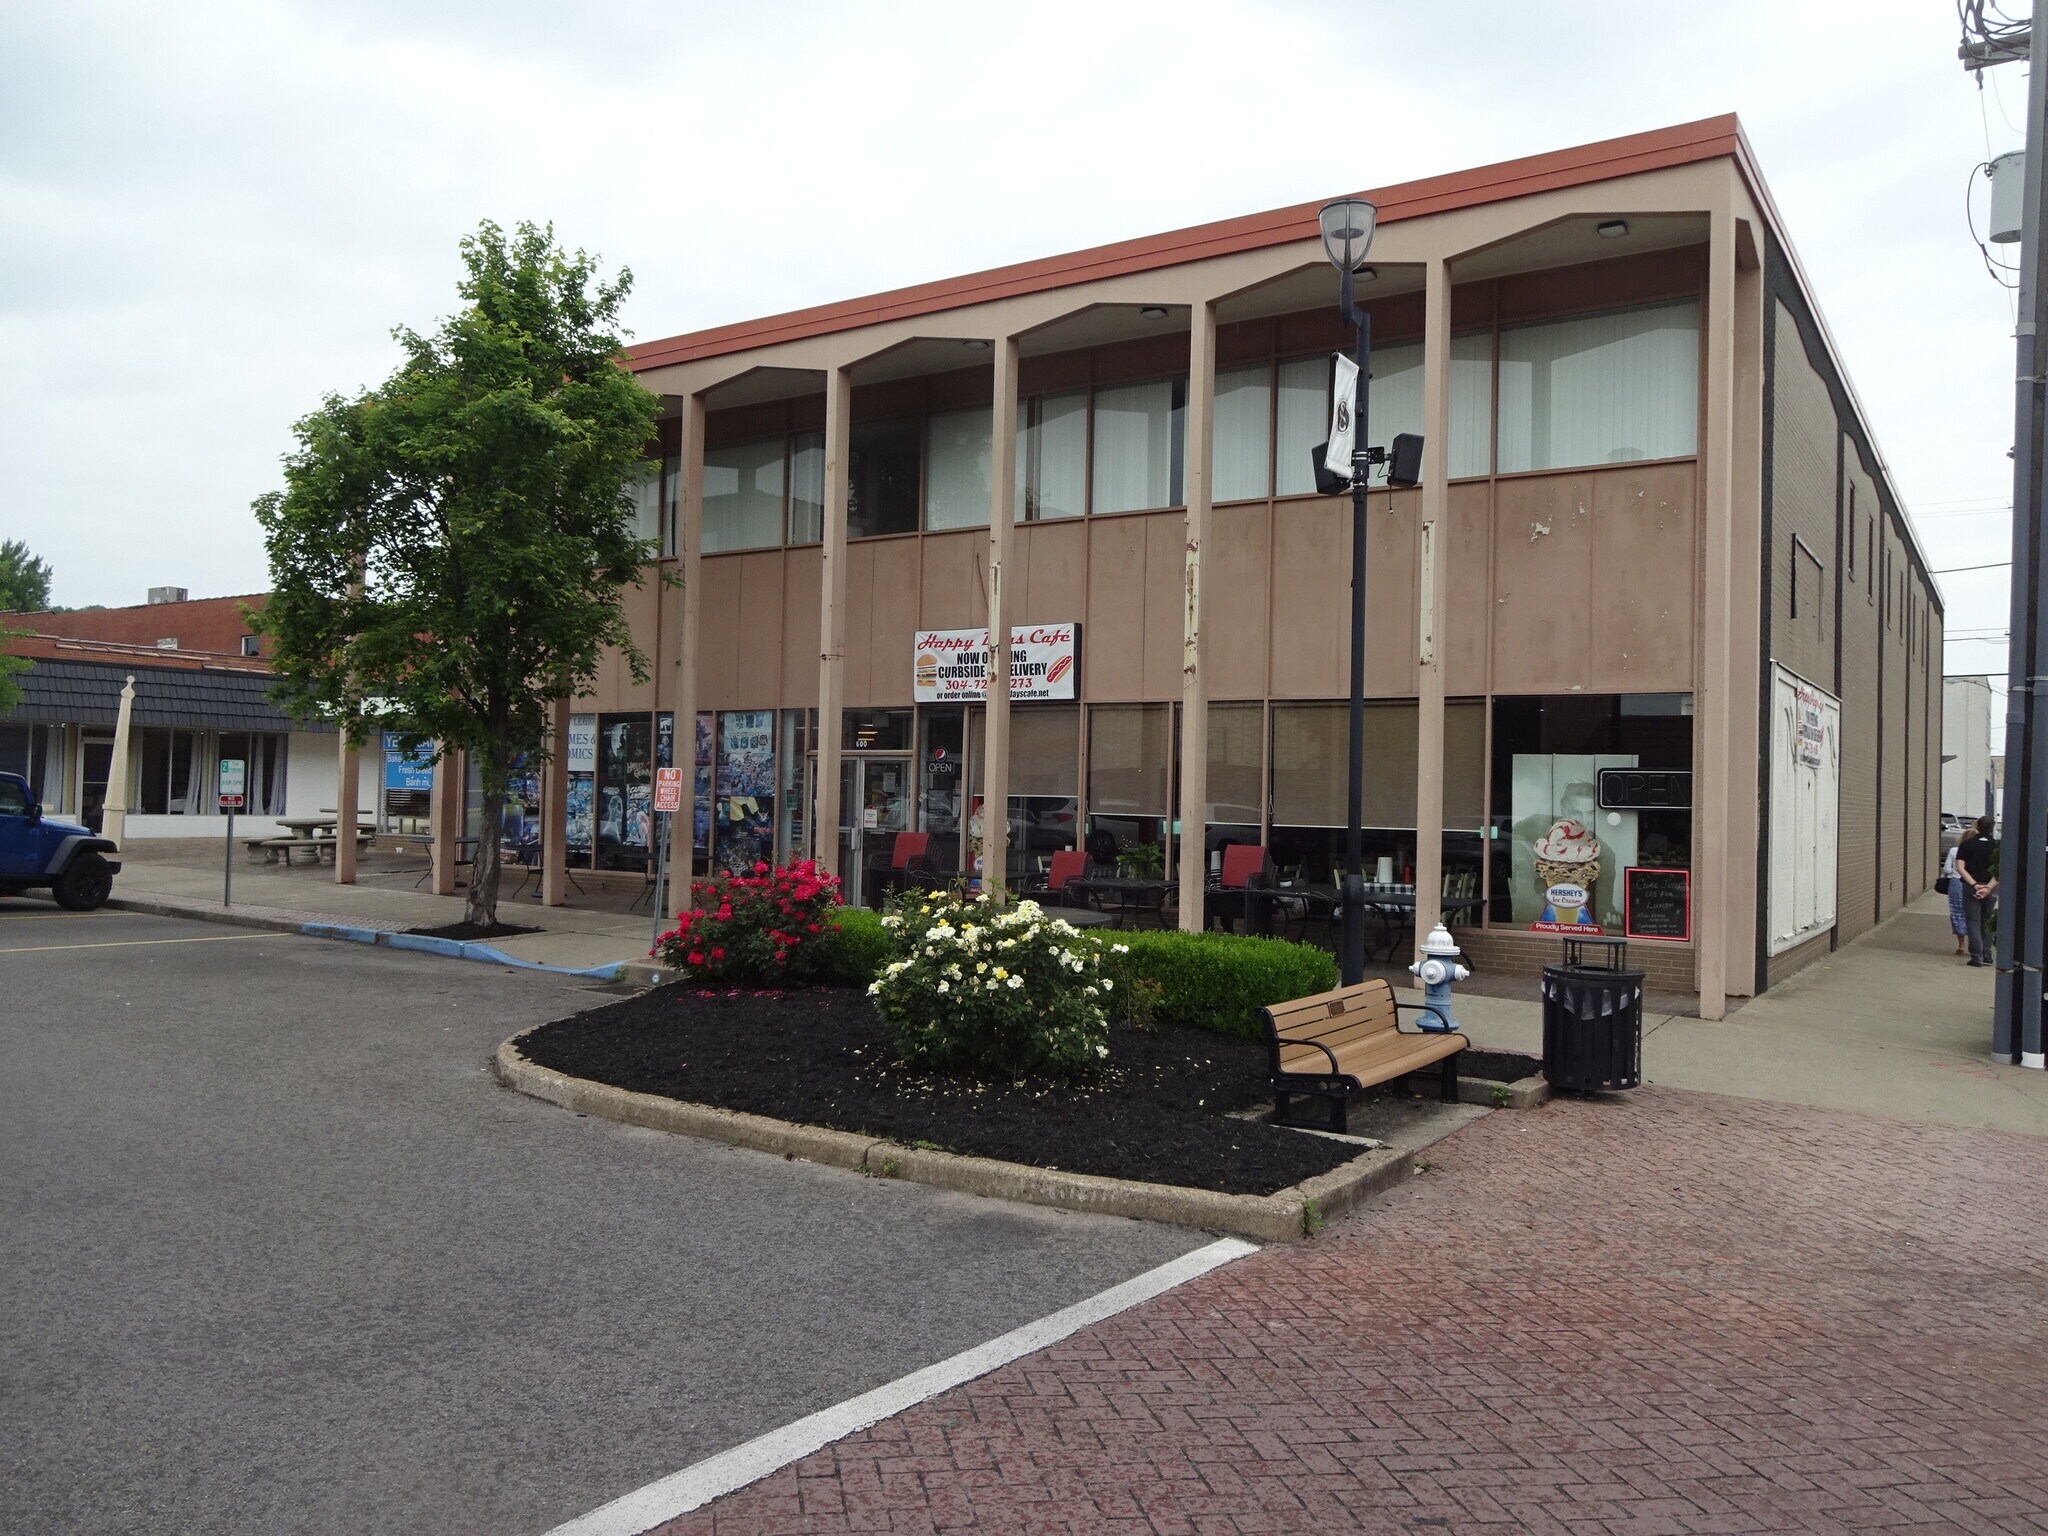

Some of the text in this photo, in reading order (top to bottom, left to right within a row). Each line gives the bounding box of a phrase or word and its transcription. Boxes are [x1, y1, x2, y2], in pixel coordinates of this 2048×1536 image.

[917, 633, 974, 651] Happy
[1029, 629, 1070, 646] Café
[957, 651, 980, 665] NOW
[938, 662, 1048, 678] CURBSIDE ELIVERY
[944, 691, 960, 699] order
[962, 690, 981, 698] online
[573, 715, 596, 726] LEGIO
[568, 733, 588, 745] MES
[856, 740, 868, 748] 600
[222, 761, 228, 771] 2
[398, 765, 415, 774] Fresh
[928, 763, 952, 773] OPEN
[664, 769, 676, 780] NO
[405, 776, 420, 787] Bánh
[658, 780, 680, 788] PARKING
[660, 787, 677, 795] WHEEL
[1604, 774, 1691, 806] OPEN
[660, 794, 676, 802] CHAIR
[656, 801, 678, 809] ACCESS
[1550, 888, 1583, 898] HERSHEY'S
[1561, 896, 1582, 904] Cream
[1535, 922, 1599, 933] Proudly Served Here
